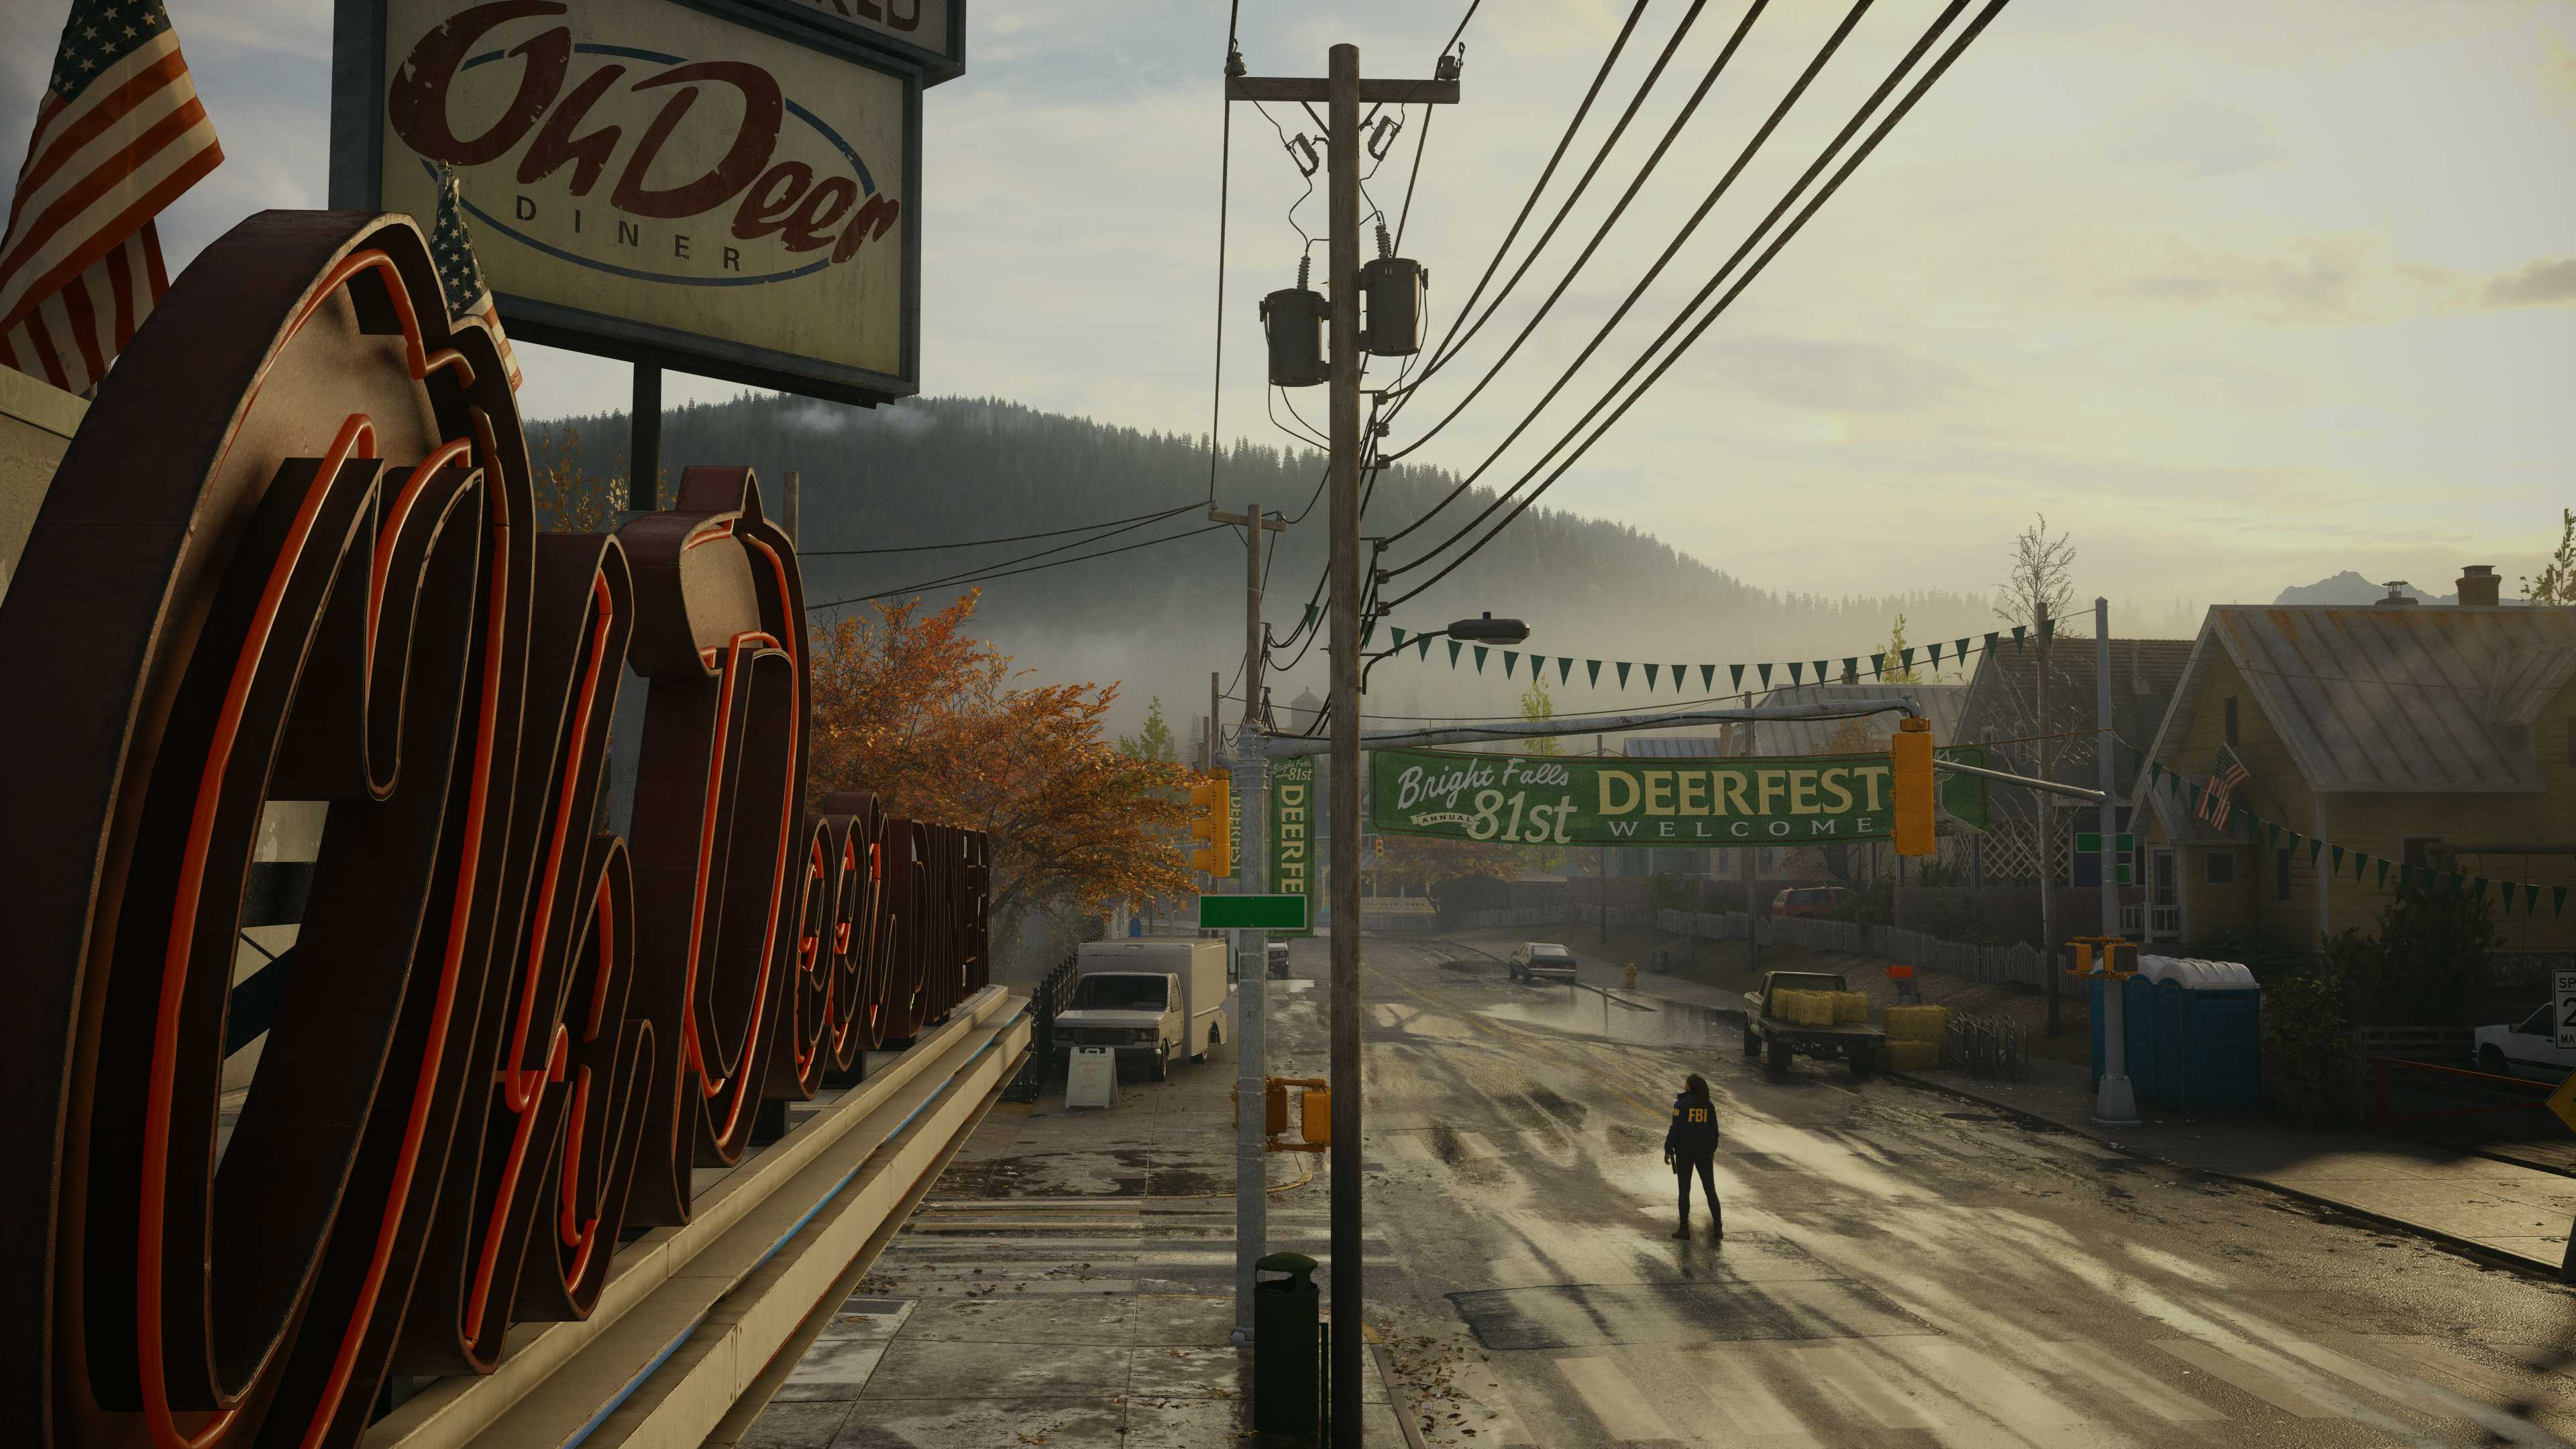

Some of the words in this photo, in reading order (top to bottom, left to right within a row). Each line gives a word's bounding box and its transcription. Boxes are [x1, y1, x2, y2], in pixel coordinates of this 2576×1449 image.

[389, 0, 627, 199] Oh
[610, 61, 900, 264] Deer
[515, 195, 741, 273] DINER
[1288, 767, 1313, 781] 81st
[1397, 757, 1495, 810] Bright
[1502, 757, 1569, 786] Falls
[1595, 765, 1890, 816] DEERFEST
[1281, 784, 1304, 894] DEERFE
[1421, 814, 1472, 824] ANNUAL
[1466, 789, 1578, 844] 81st
[1608, 817, 1873, 837] WELCOME
[2559, 977, 2576, 989] SP
[2561, 1034, 2576, 1044] MA
[1688, 1108, 1707, 1123] FBI
